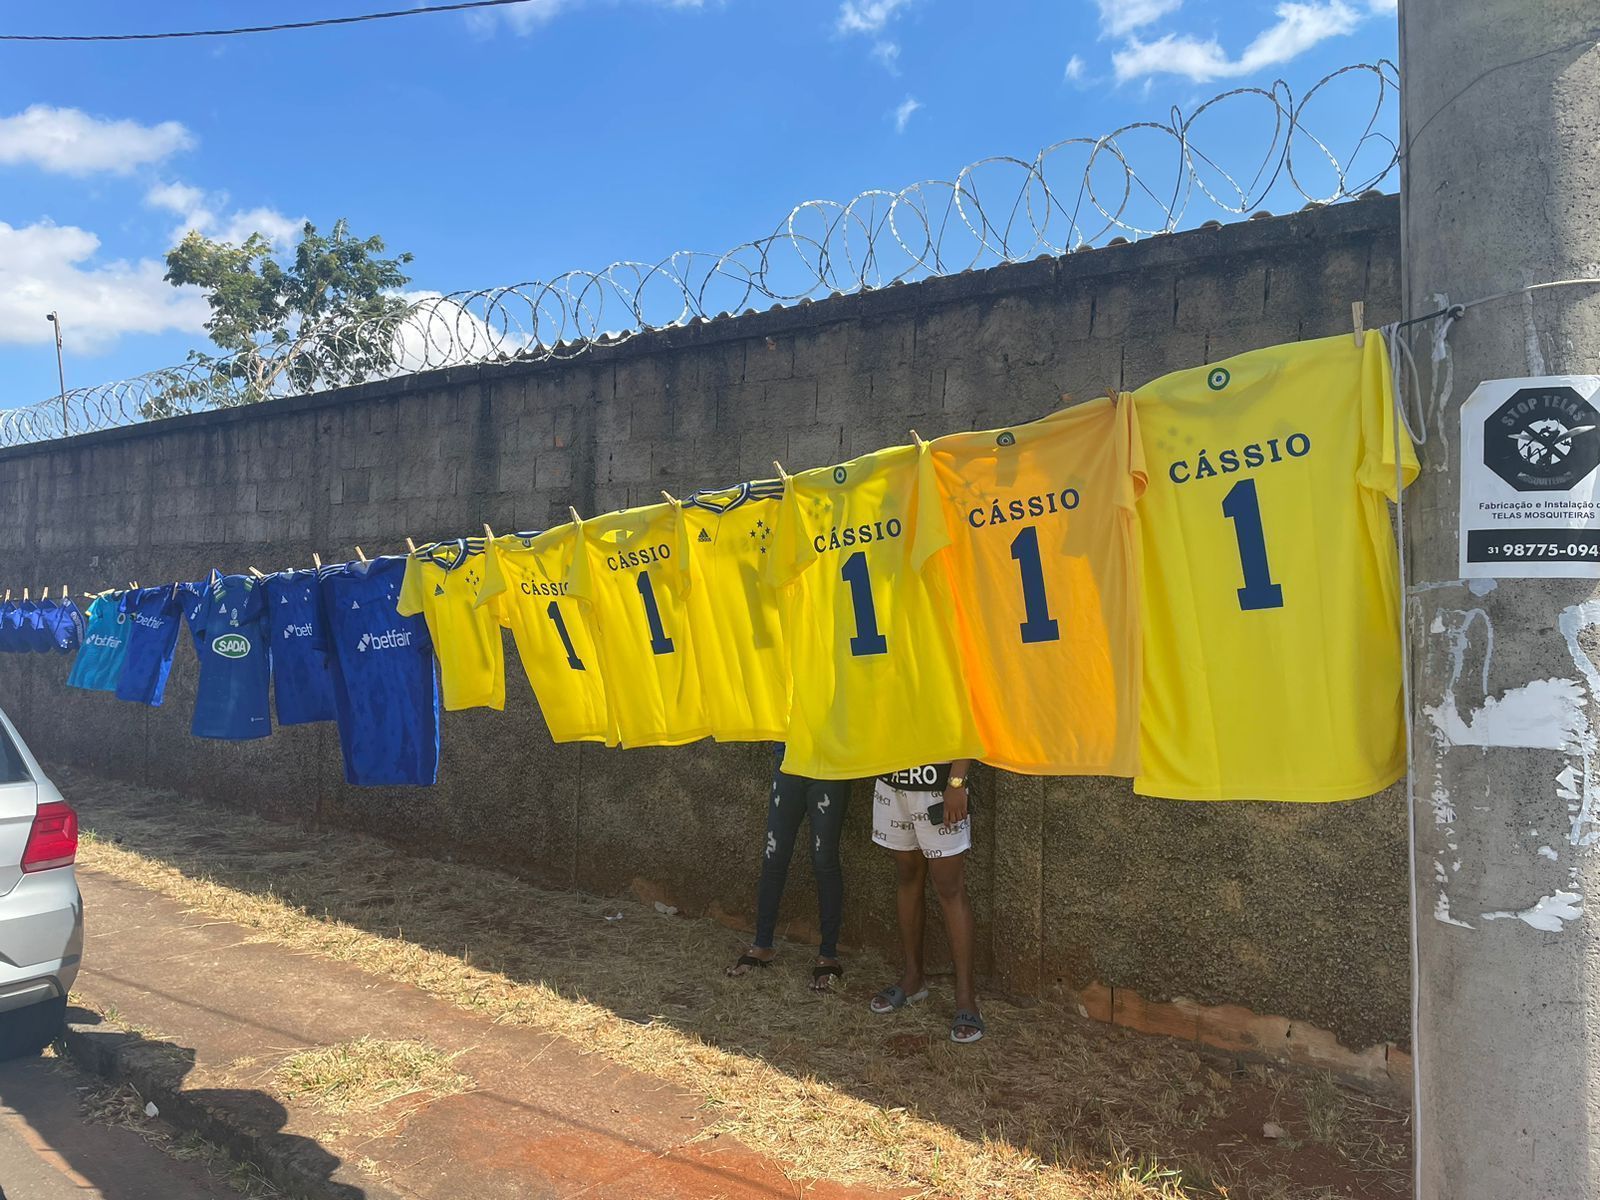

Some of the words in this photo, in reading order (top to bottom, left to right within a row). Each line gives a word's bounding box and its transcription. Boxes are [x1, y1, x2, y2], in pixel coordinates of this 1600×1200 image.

[1502, 398, 1538, 426] STOP
[1541, 395, 1586, 421] TELAS
[1169, 432, 1312, 484] CÁSSIO
[968, 488, 1081, 528] CÁSSIO
[1479, 501, 1533, 510] Fabricação
[1544, 500, 1594, 510] Instalação
[1492, 511, 1522, 520] TELAS
[1524, 511, 1596, 519] MOSQUITEIRAS
[813, 518, 902, 553] CÁSSIO
[1221, 477, 1284, 611] 1
[1487, 546, 1499, 554] 31
[1502, 543, 1600, 557] 98775-094
[607, 543, 671, 571] CÁSSIO
[1010, 525, 1061, 644] 1
[636, 570, 675, 655] 1
[841, 551, 888, 657] 1
[218, 639, 247, 653] SADA
[369, 628, 412, 650] betfair
[546, 600, 587, 672] 1
